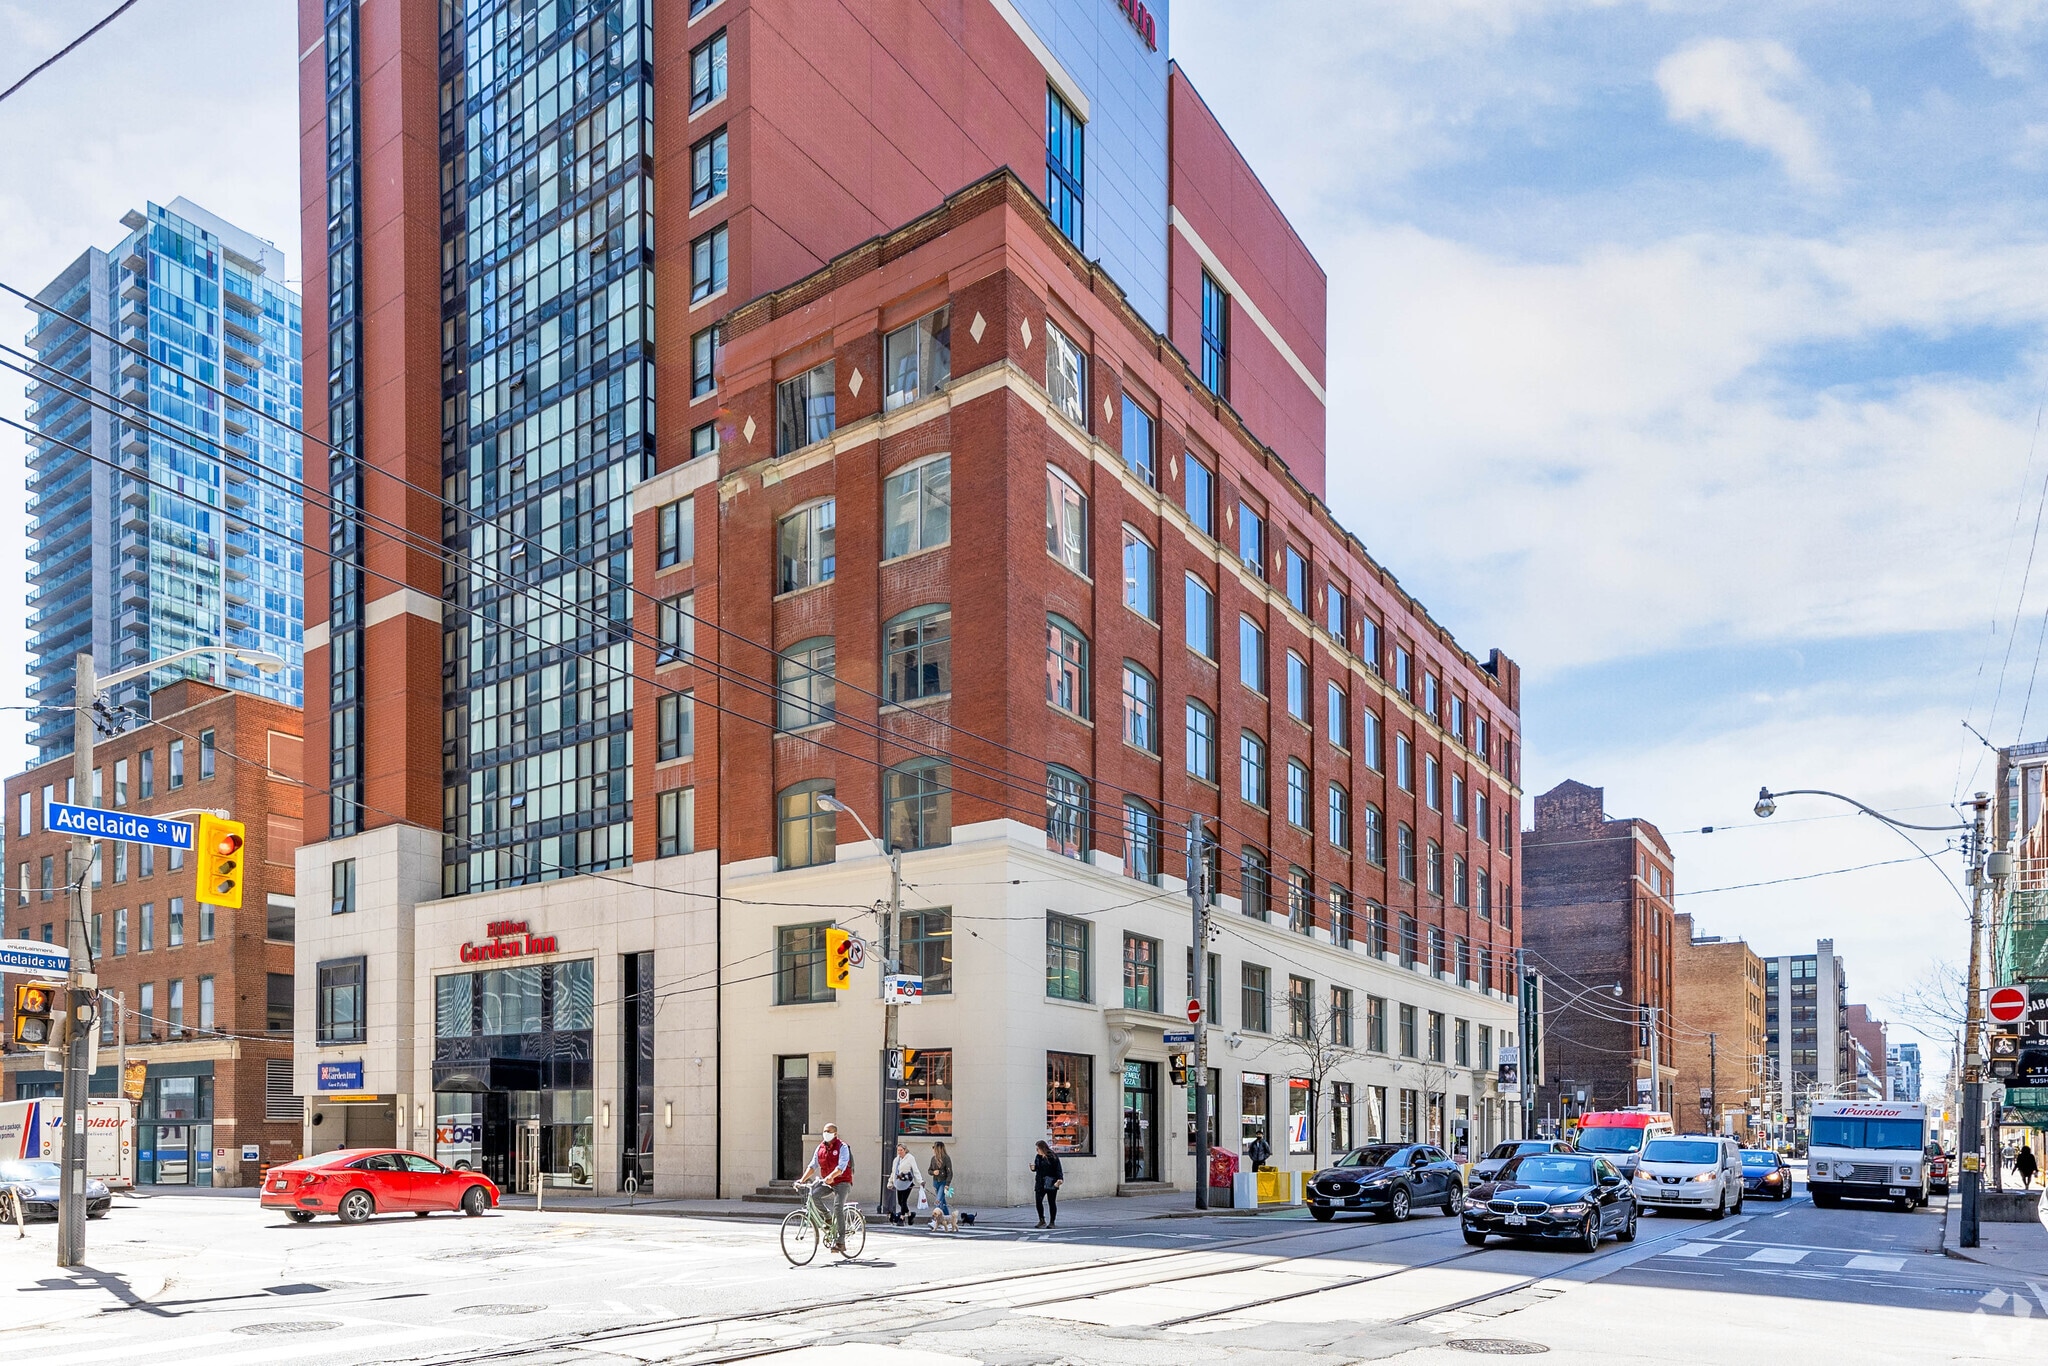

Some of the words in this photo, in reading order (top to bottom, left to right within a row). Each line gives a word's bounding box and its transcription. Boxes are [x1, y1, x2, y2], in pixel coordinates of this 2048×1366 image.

[56, 808, 149, 838] Adelaide
[157, 822, 168, 834] St
[171, 825, 188, 844] W
[487, 919, 527, 937] Hilton
[460, 937, 522, 963] Garden
[524, 932, 557, 955] Inn
[47, 959, 56, 968] St
[57, 958, 67, 969] W
[1845, 1107, 1902, 1117] Purolator
